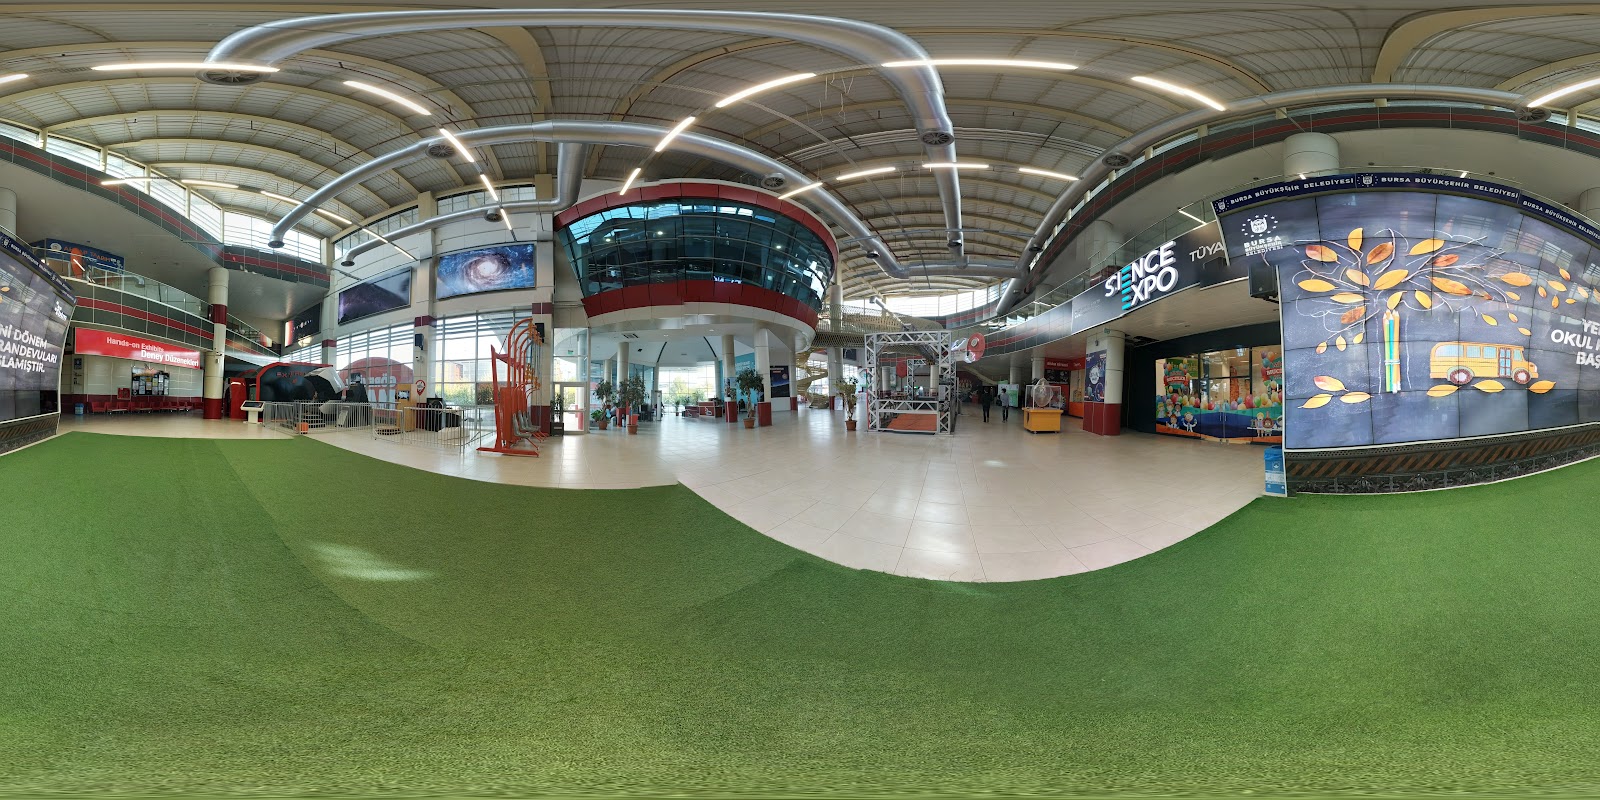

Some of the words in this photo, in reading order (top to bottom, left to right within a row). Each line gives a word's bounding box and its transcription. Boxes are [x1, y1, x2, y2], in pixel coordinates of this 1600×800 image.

[1230, 194, 1252, 205] BURSA
[1303, 178, 1354, 189] BELEDİYESİ
[1415, 177, 1470, 189] BÜYÜKŞEHİR
[1473, 184, 1519, 199] BELEDİYESİ
[1523, 200, 1543, 212] BURSA
[1244, 235, 1281, 248] BURSA
[1121, 266, 1179, 311] EXPO
[1581, 318, 1600, 336] YE
[13, 328, 48, 349] DÖNEM
[106, 336, 140, 349] Hands-on
[141, 342, 165, 352] Exhibits
[1551, 329, 1594, 350] OKUL
[0, 355, 45, 373] LAMIŞTIR.
[141, 350, 164, 363] Deney
[165, 353, 199, 367] Düzenekleri
